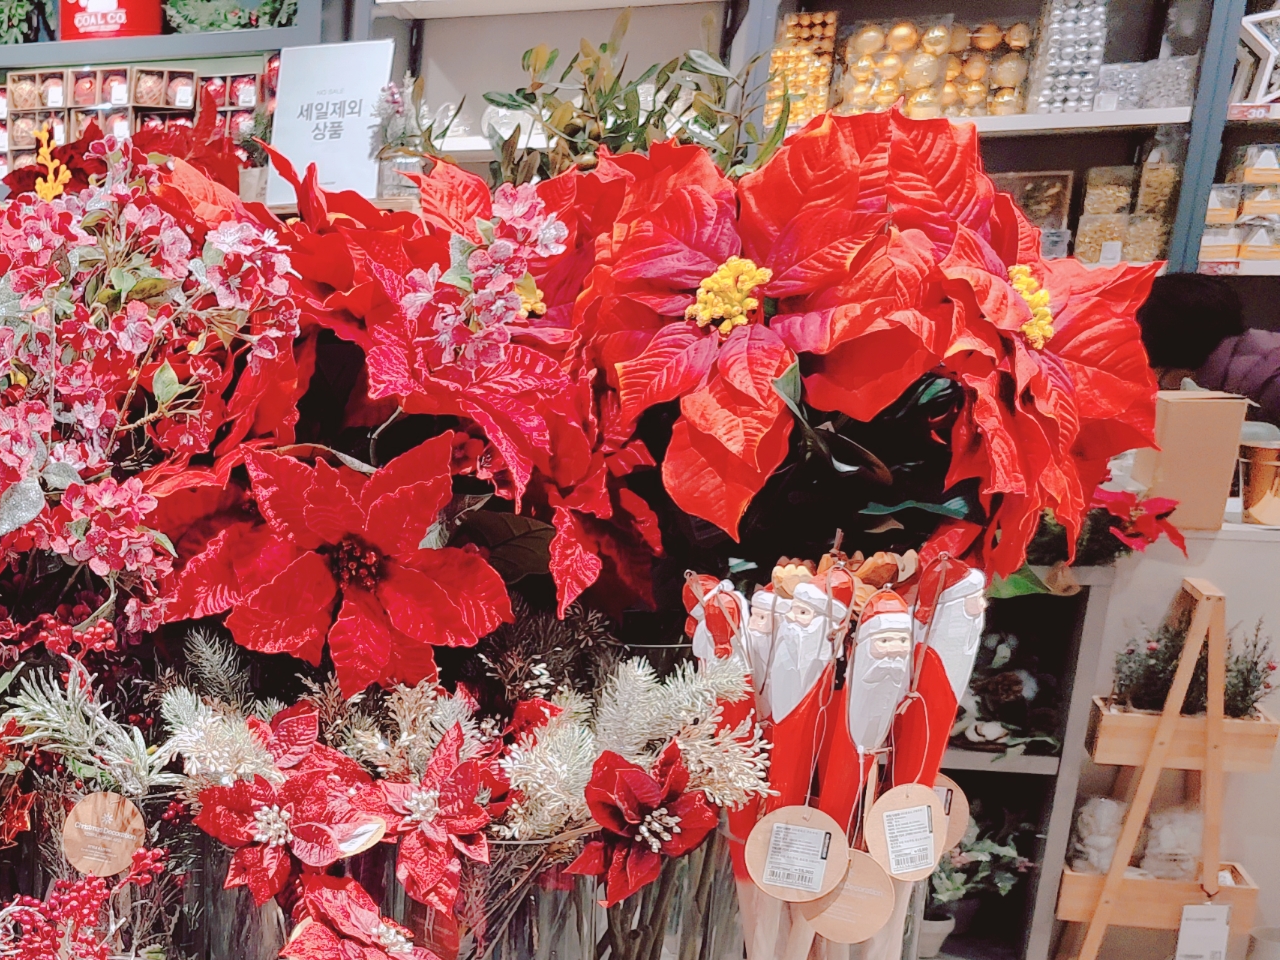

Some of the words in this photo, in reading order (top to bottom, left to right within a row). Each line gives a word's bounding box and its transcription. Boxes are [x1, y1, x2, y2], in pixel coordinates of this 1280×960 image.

[75, 13, 104, 28] COAL
[297, 99, 363, 121] 세일제외
[311, 121, 344, 141] 상품
